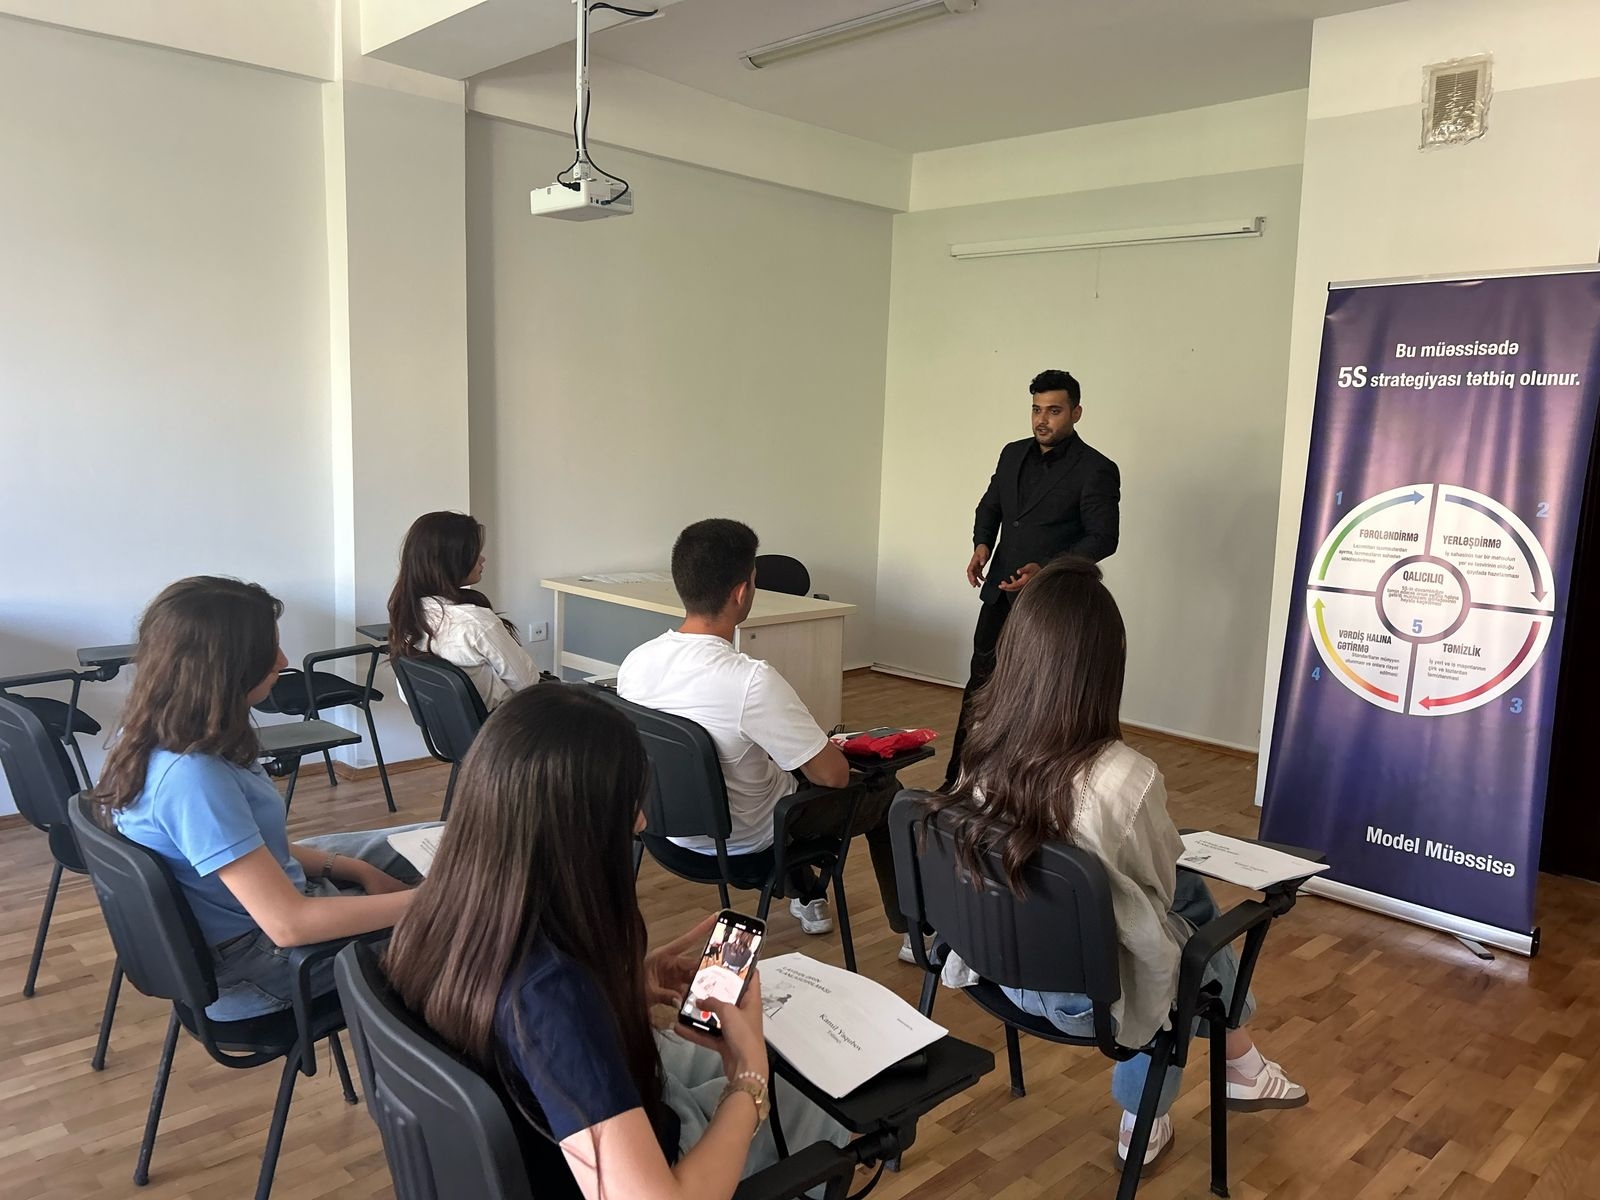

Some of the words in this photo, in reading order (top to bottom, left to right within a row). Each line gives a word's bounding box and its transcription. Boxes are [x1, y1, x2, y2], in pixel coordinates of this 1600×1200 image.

[1395, 343, 1416, 358] Bu
[1420, 340, 1519, 357] müəssisədə
[1338, 366, 1367, 388] 5S
[1370, 372, 1461, 390] strategiyası
[1466, 370, 1515, 389] tətbiq
[1519, 370, 1580, 386] olunur.
[1336, 491, 1343, 505] 1
[1536, 502, 1549, 518] 2
[1360, 529, 1419, 542] FƏRQLƏNDİRMƏ
[1443, 535, 1502, 549] YERLƏŞDİRMƏ
[1403, 571, 1444, 585] QALICILIQ
[1412, 619, 1423, 634] 5
[1339, 630, 1365, 643] VƏRDİŞ
[1366, 633, 1392, 644] HALINA
[1337, 641, 1369, 653] GƏTİRMƏ
[1443, 643, 1481, 657] TƏMİZLİK
[1311, 667, 1320, 680] 4
[1510, 697, 1522, 713] 3
[1366, 826, 1420, 854] Model
[1425, 840, 1516, 877] Müəssisə
